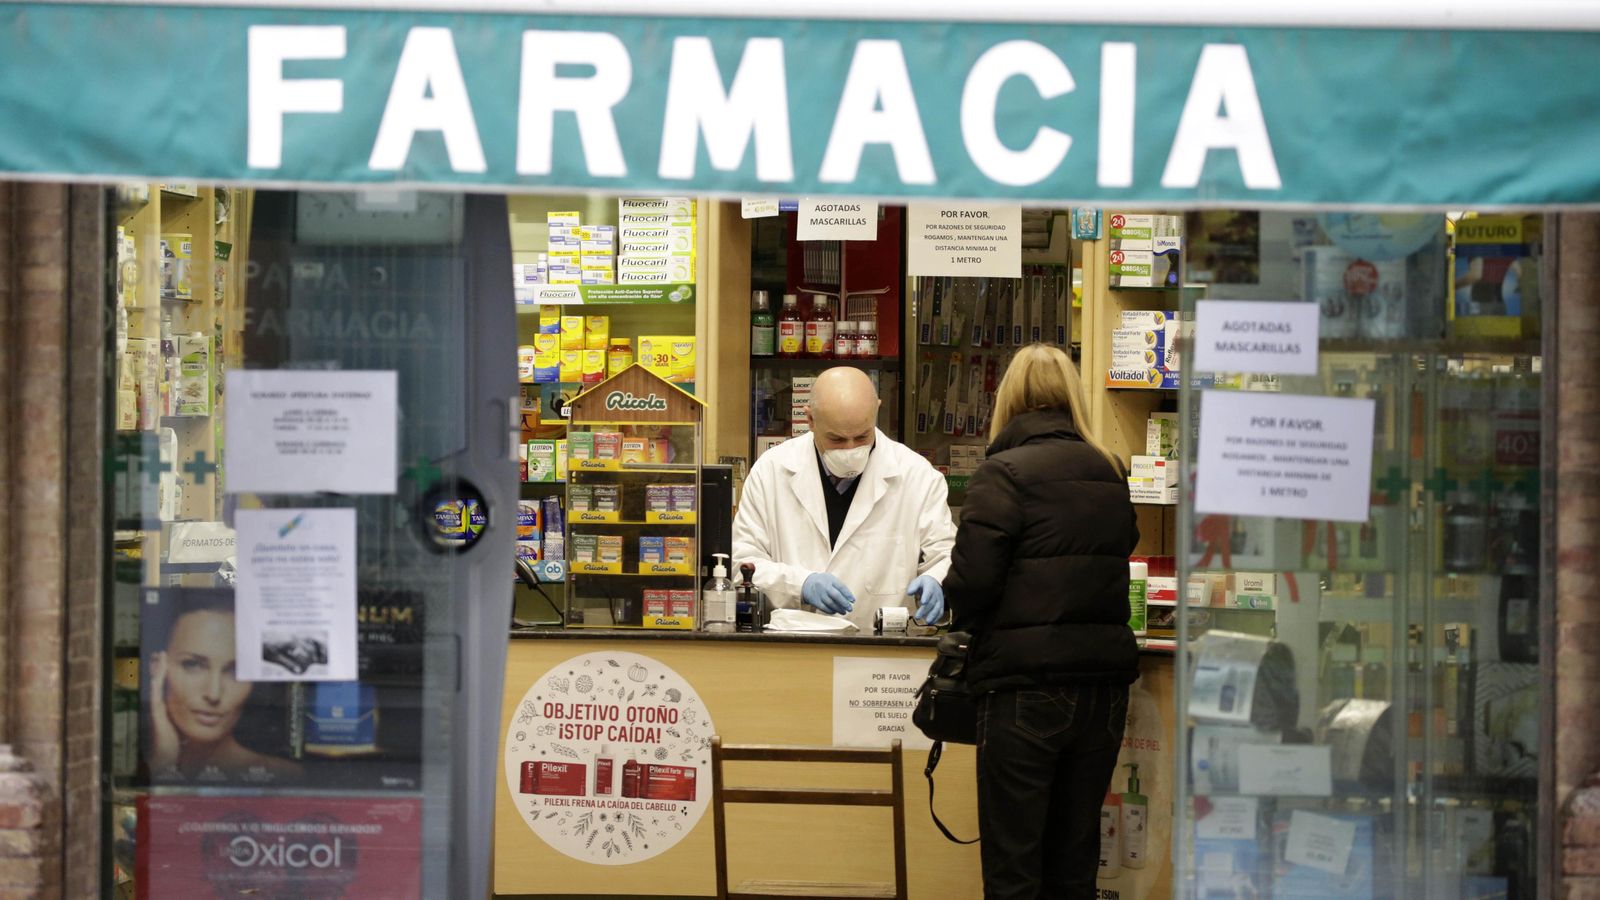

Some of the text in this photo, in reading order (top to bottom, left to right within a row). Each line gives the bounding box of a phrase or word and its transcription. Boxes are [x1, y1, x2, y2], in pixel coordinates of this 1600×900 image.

[246, 25, 1282, 190] FARMACIA
[622, 199, 669, 208] Fluocaril
[814, 204, 861, 212] AGOTADAS
[622, 214, 669, 222] Fluocaril
[940, 210, 958, 218] POR
[809, 217, 867, 226] MASCARILLAS
[622, 229, 669, 237] Fluocaril
[1457, 224, 1518, 239] FUTURO
[622, 243, 669, 251] Fluocaril
[621, 258, 668, 266] Fluocaril
[621, 272, 668, 280] Fluocaril
[538, 290, 577, 299] Fluocaril
[1222, 320, 1292, 334] AGOTADAS
[1215, 340, 1302, 355] MASCARILLAS
[1109, 370, 1145, 380] Voltadol
[606, 390, 667, 411] Ricola
[1249, 416, 1277, 428] POR
[1225, 436, 1349, 451] POR RAZONES DE SEGURIDAD
[581, 460, 606, 468] Ricola
[1272, 454, 1328, 465] MANTENGAN
[1330, 457, 1350, 467] UNA
[1237, 467, 1282, 478] DISTANCIA
[1320, 472, 1332, 481] DE
[1268, 486, 1309, 499] METRO
[435, 513, 461, 521] TAMPAX
[581, 513, 606, 521] Ricola
[658, 513, 684, 521] Ricola
[182, 537, 235, 548] FORMATOS DE
[584, 564, 609, 572] Ricola
[651, 565, 676, 573] Ricola
[655, 618, 680, 626] Ricola
[872, 673, 886, 681] POR
[849, 700, 860, 708] NO
[862, 700, 904, 708] SOBREPASEN
[543, 702, 678, 725] OBJETIVO OTOÑO
[874, 711, 908, 720] DEL SUELO
[558, 723, 662, 744] ¡STOP CAÍDA!
[877, 725, 906, 733] GRACIAS
[541, 762, 568, 773] Pilexil
[649, 765, 670, 774] Pilexil
[544, 798, 677, 812] PILEXIL FRENA LA CAÍDA DEL CABELLO
[229, 835, 342, 868] Oxicol
